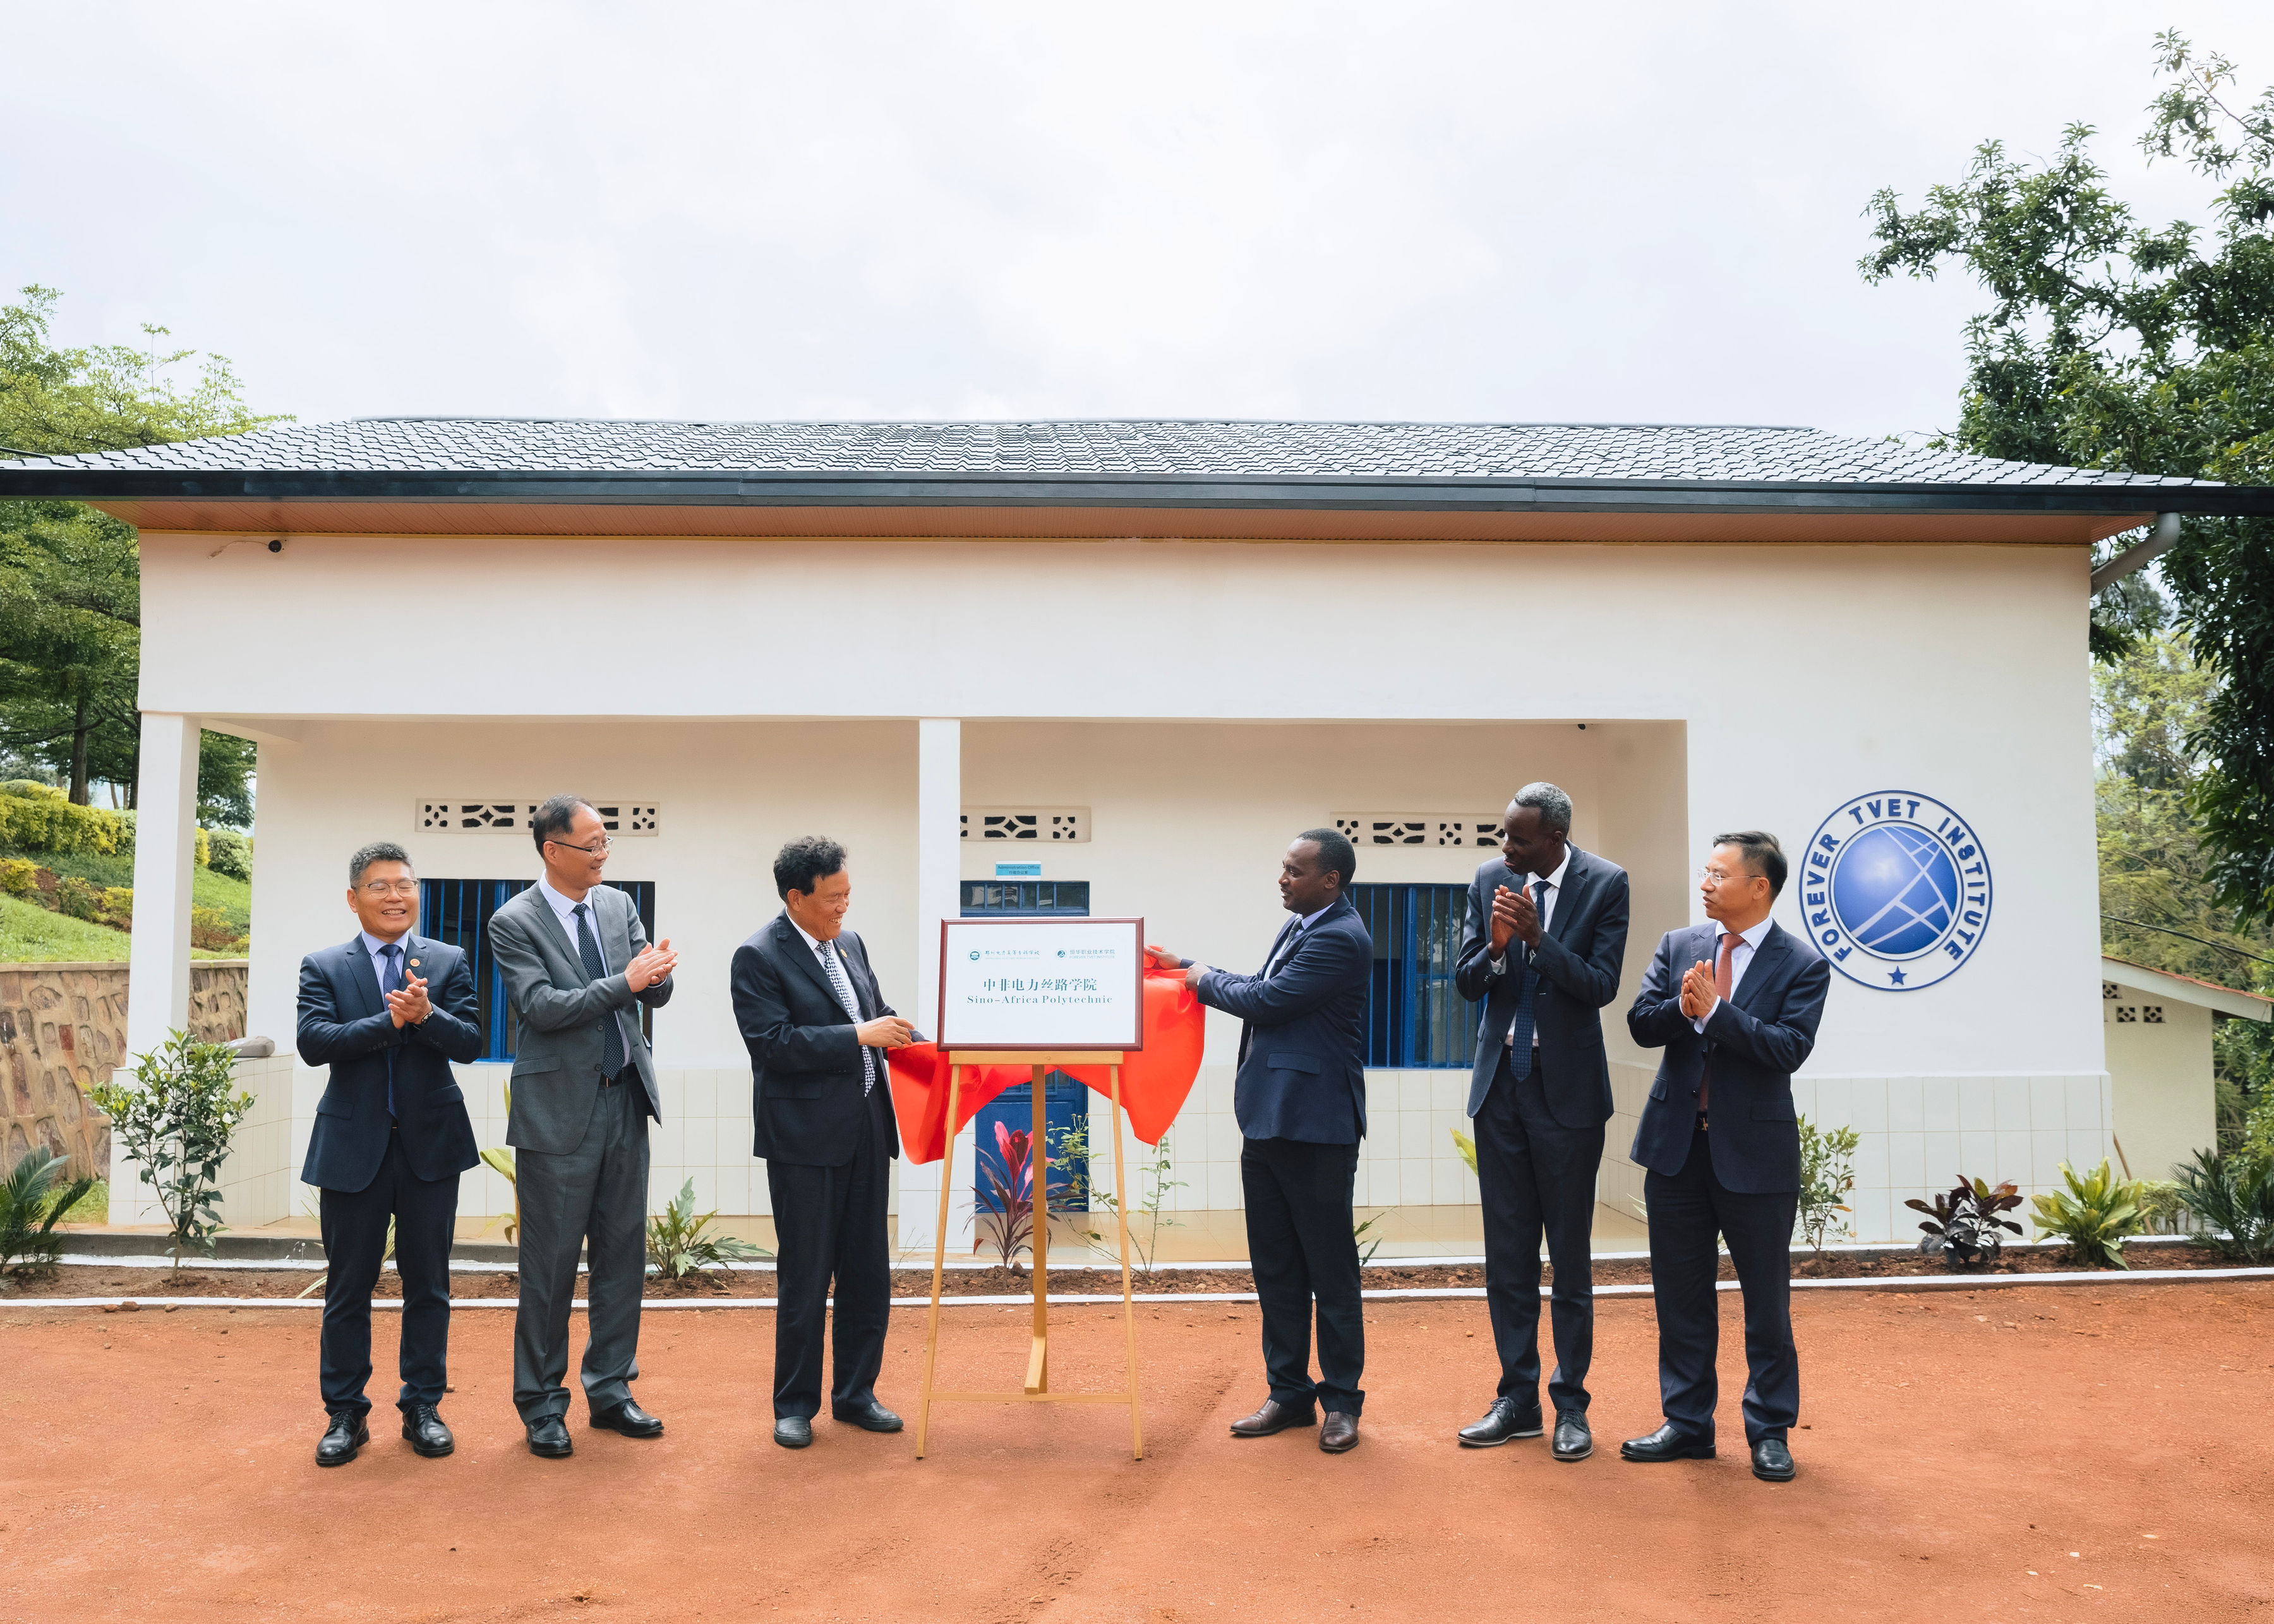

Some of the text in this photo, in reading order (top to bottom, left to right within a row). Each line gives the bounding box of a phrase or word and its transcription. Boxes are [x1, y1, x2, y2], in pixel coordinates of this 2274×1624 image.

[1807, 798, 1985, 962] FOREVER TVET INSTITUTE
[984, 978, 1097, 992] 中非电力丝路学院
[967, 995, 1112, 1005] Sino-Africa Polytechnic
